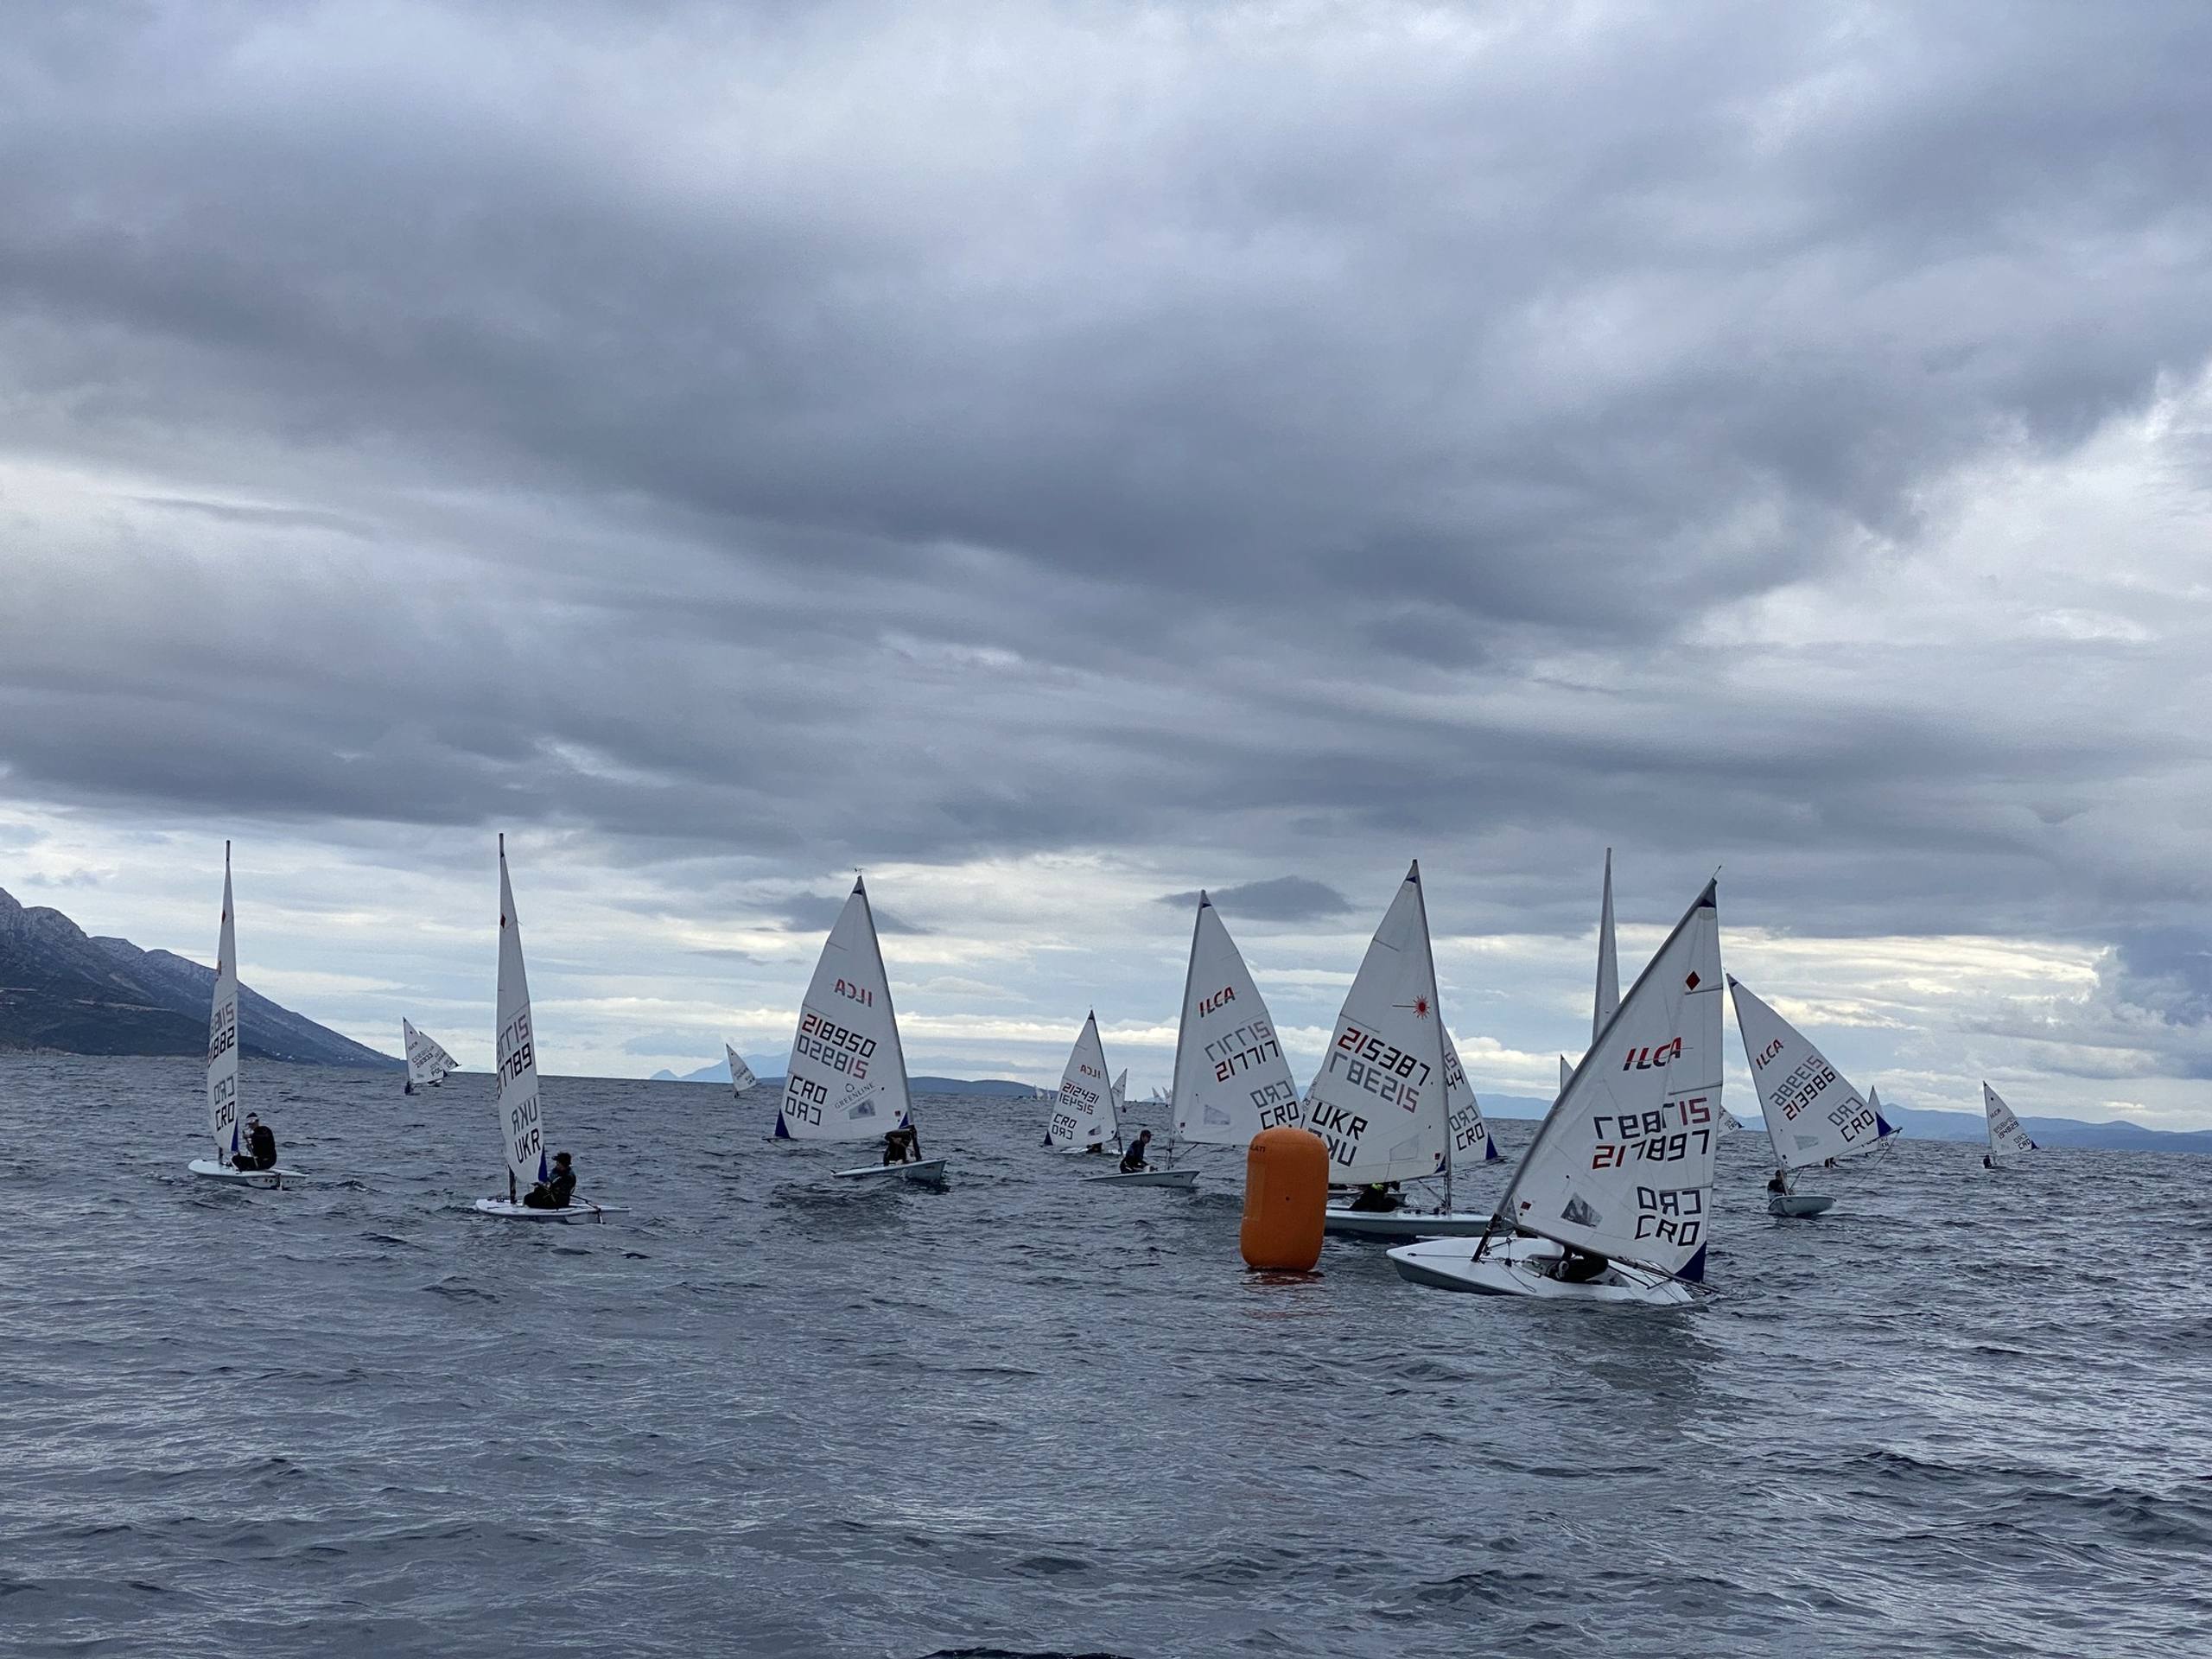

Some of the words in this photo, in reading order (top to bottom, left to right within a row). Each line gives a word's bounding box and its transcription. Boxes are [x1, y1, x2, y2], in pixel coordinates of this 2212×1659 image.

[1199, 986, 1236, 1018] ILCA
[801, 1013, 877, 1058] 218950
[1215, 1040, 1280, 1083] 217717
[1337, 1027, 1431, 1086] 215387
[1623, 1037, 1681, 1071] ILCA
[1755, 1039, 1784, 1071] ILCA
[789, 1075, 828, 1105] CRO
[1062, 1082, 1100, 1104] 212431
[1783, 1066, 1836, 1122] 213986
[215, 1100, 235, 1132] CRO
[1053, 1113, 1077, 1128] CRO
[1260, 1100, 1300, 1130] CRO
[1311, 1102, 1369, 1141] UKR
[1840, 1109, 1876, 1143] CRO
[514, 1128, 541, 1165] UKR
[1456, 1122, 1485, 1151] CRO
[1592, 1128, 1710, 1170] 217897
[1634, 1214, 1701, 1247] CRO
